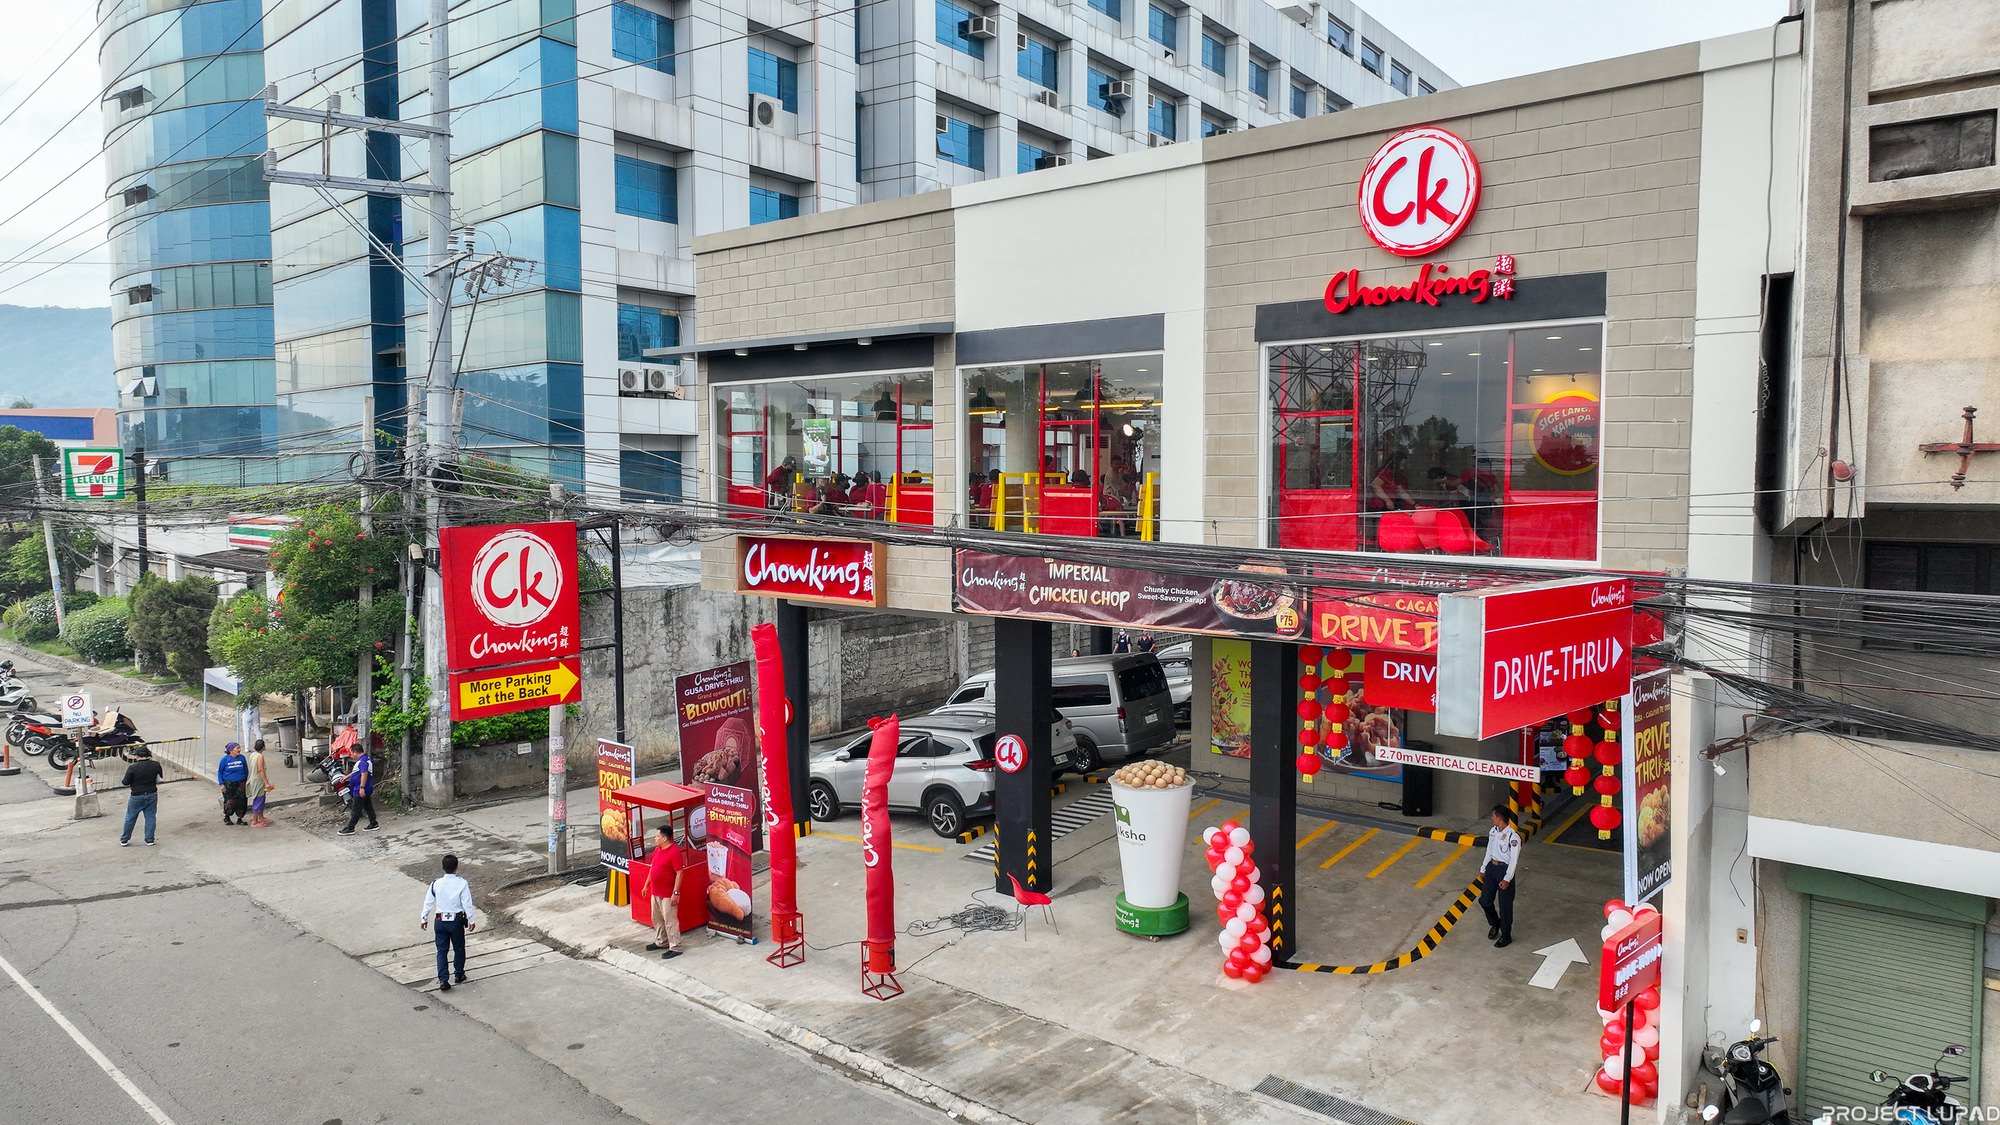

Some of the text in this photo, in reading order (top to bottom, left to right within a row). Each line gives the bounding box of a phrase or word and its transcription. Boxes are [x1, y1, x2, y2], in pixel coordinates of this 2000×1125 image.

[1373, 146, 1458, 227] Ck
[1325, 263, 1491, 314] Chowking
[1538, 411, 1560, 431] SIGE
[1551, 417, 1575, 437] KAIN
[78, 456, 113, 496] 7
[484, 546, 554, 609] Ck
[745, 543, 860, 596] Chowking
[962, 567, 1019, 592] Chowking
[1049, 563, 1111, 583] IMPERIAL
[1028, 585, 1131, 612] CHICKEN CHOP
[1137, 592, 1207, 605] Sweet-Savory Sarap!
[1143, 585, 1200, 597] Chunky Chicken,
[1591, 585, 1622, 608] Chowking
[1321, 613, 1412, 647] DRIVE
[470, 630, 558, 659] Chowking
[695, 668, 728, 686] Chowking
[1493, 637, 1610, 700] DRIVE-THRU
[470, 672, 552, 694] More Parking
[478, 684, 549, 706] at the Back
[684, 675, 744, 697] GUSA DRIVE-THRU
[1634, 680, 1667, 707] Chowking
[685, 688, 747, 720] BLOWOUT!
[598, 744, 628, 763] Chowking
[1635, 721, 1671, 762] DRIVE
[997, 742, 1019, 767] Ck
[1379, 748, 1535, 779] 2.70m VERTICAL CLEARANCE
[599, 769, 631, 790] DRIVE
[1635, 754, 1661, 788] THRU
[711, 786, 740, 802] Chowking
[720, 799, 749, 810] DRIVE-THRU
[709, 810, 747, 828] BLOWOUT!
[600, 850, 616, 862] NOW
[1638, 860, 1671, 895] NOW OPEN
